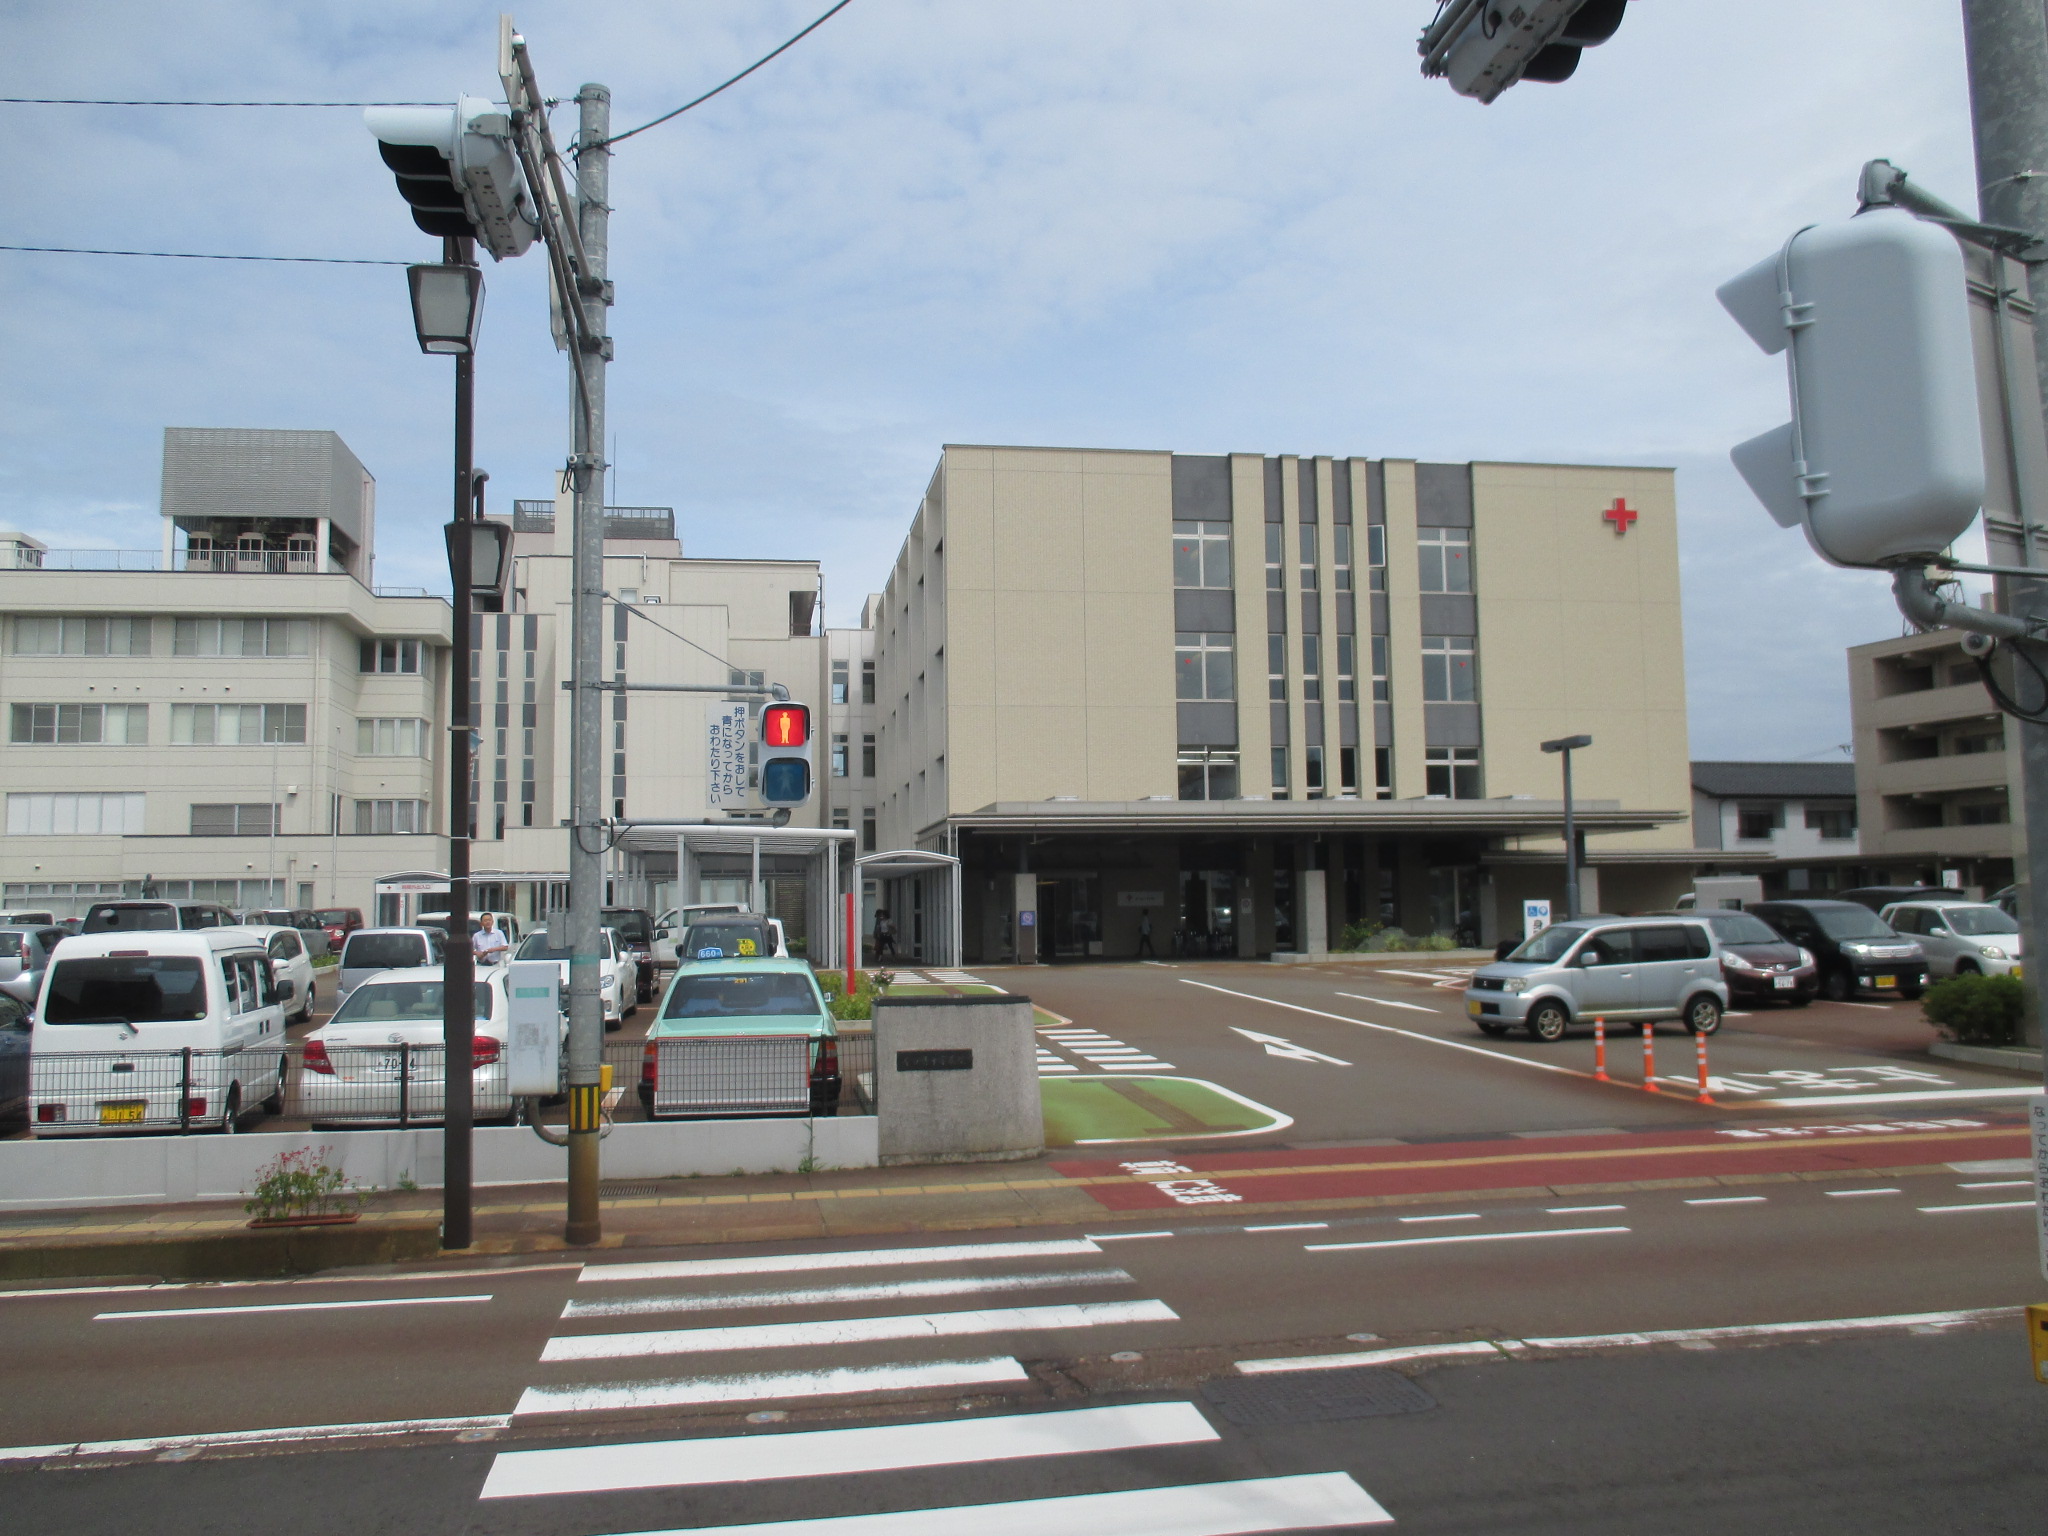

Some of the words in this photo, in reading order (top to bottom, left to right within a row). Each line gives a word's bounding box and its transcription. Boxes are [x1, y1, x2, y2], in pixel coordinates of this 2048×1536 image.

[709, 723, 721, 804] おわたり下さい
[721, 715, 733, 795] 青になってから
[734, 706, 745, 798] 押ボタンをおして
[385, 1057, 415, 1070] 70-4
